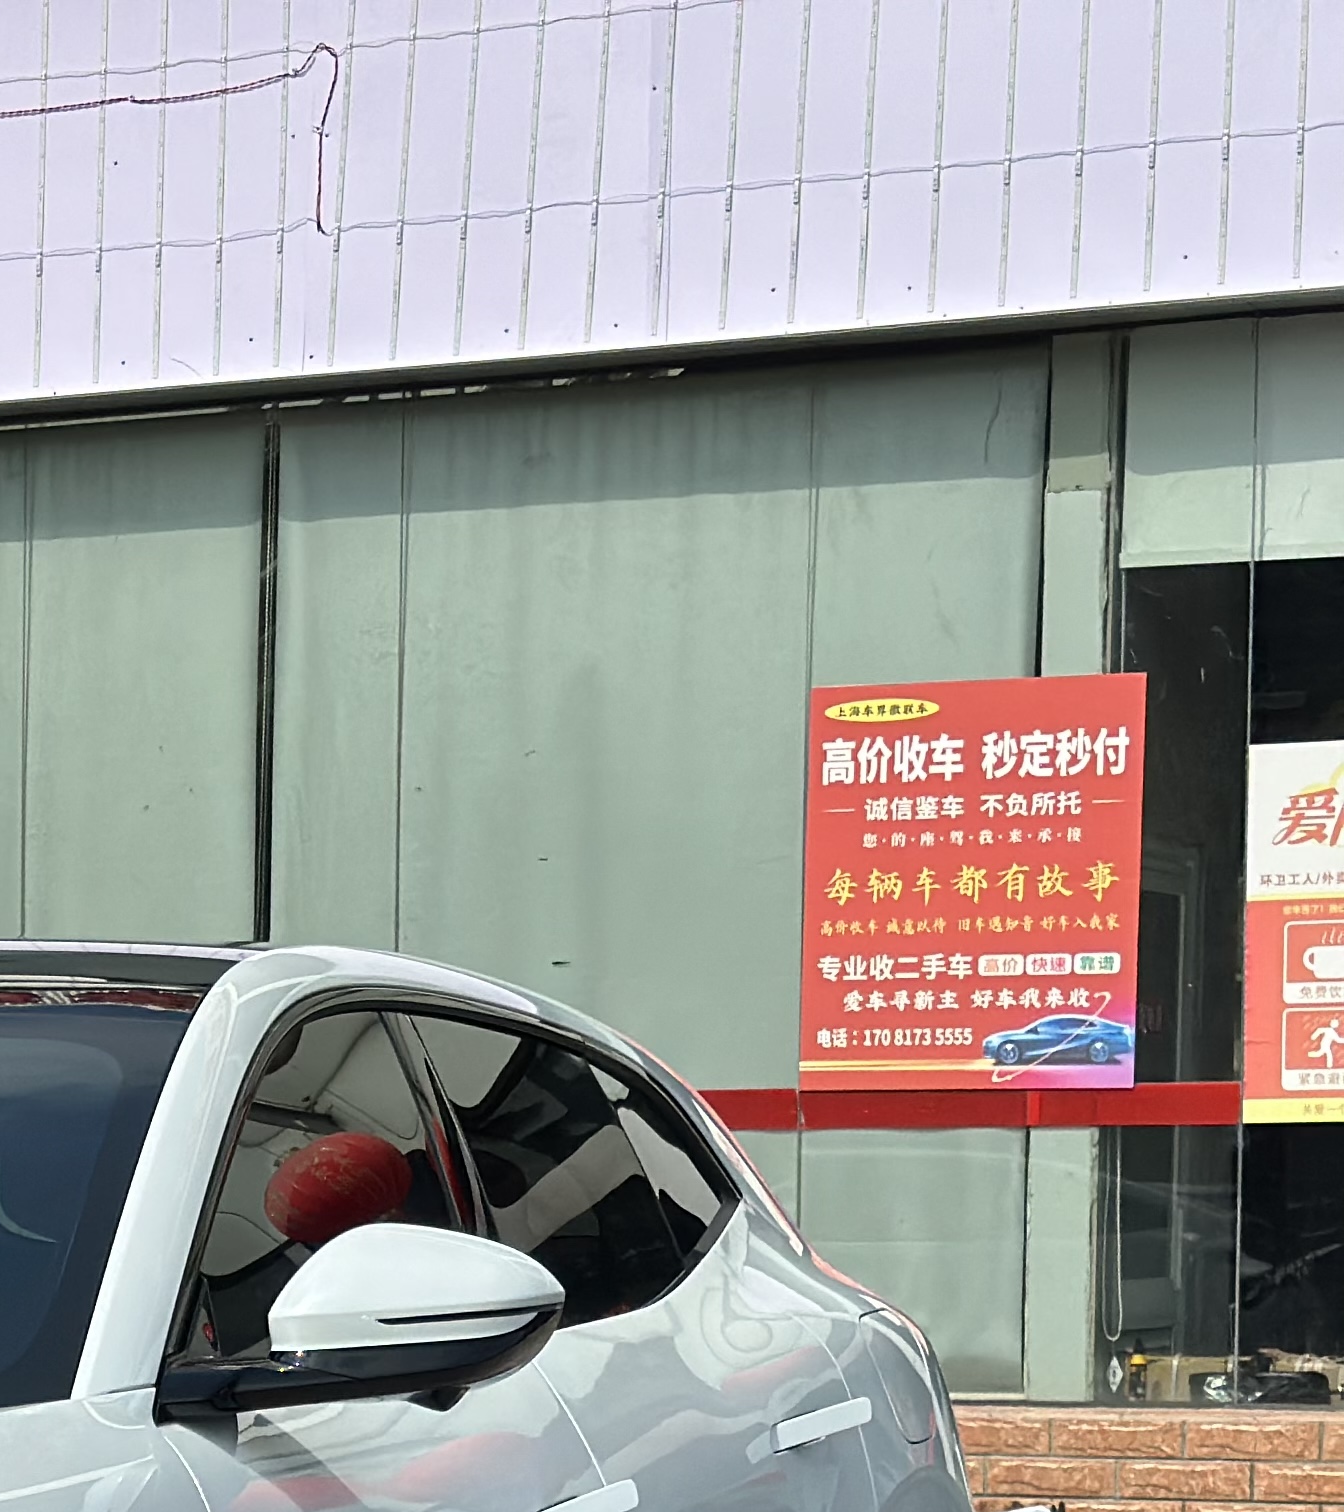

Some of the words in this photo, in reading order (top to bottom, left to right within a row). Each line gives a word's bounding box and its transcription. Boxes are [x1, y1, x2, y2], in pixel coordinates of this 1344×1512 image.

[821, 733, 965, 786] 高价收车
[981, 726, 1130, 780] 秒定秒付
[863, 795, 965, 822] 诚信鉴车
[979, 790, 1082, 818] 不负所托
[1272, 787, 1344, 847] 爱
[823, 859, 1120, 906] 每辆车都有故事
[820, 917, 879, 937] 高价收车
[817, 953, 973, 981] 专业收二手车
[983, 956, 1019, 973] 高价
[1031, 955, 1066, 973] 快速
[1079, 954, 1115, 972] 靠谱
[843, 989, 960, 1013] 爱车寻新主
[970, 987, 1090, 1010] 好车我来收
[1299, 985, 1344, 1000] 免费饮
[894, 1027, 932, 1046] 8173
[935, 1026, 973, 1046] 5555
[1298, 1071, 1344, 1086] 紧急避
